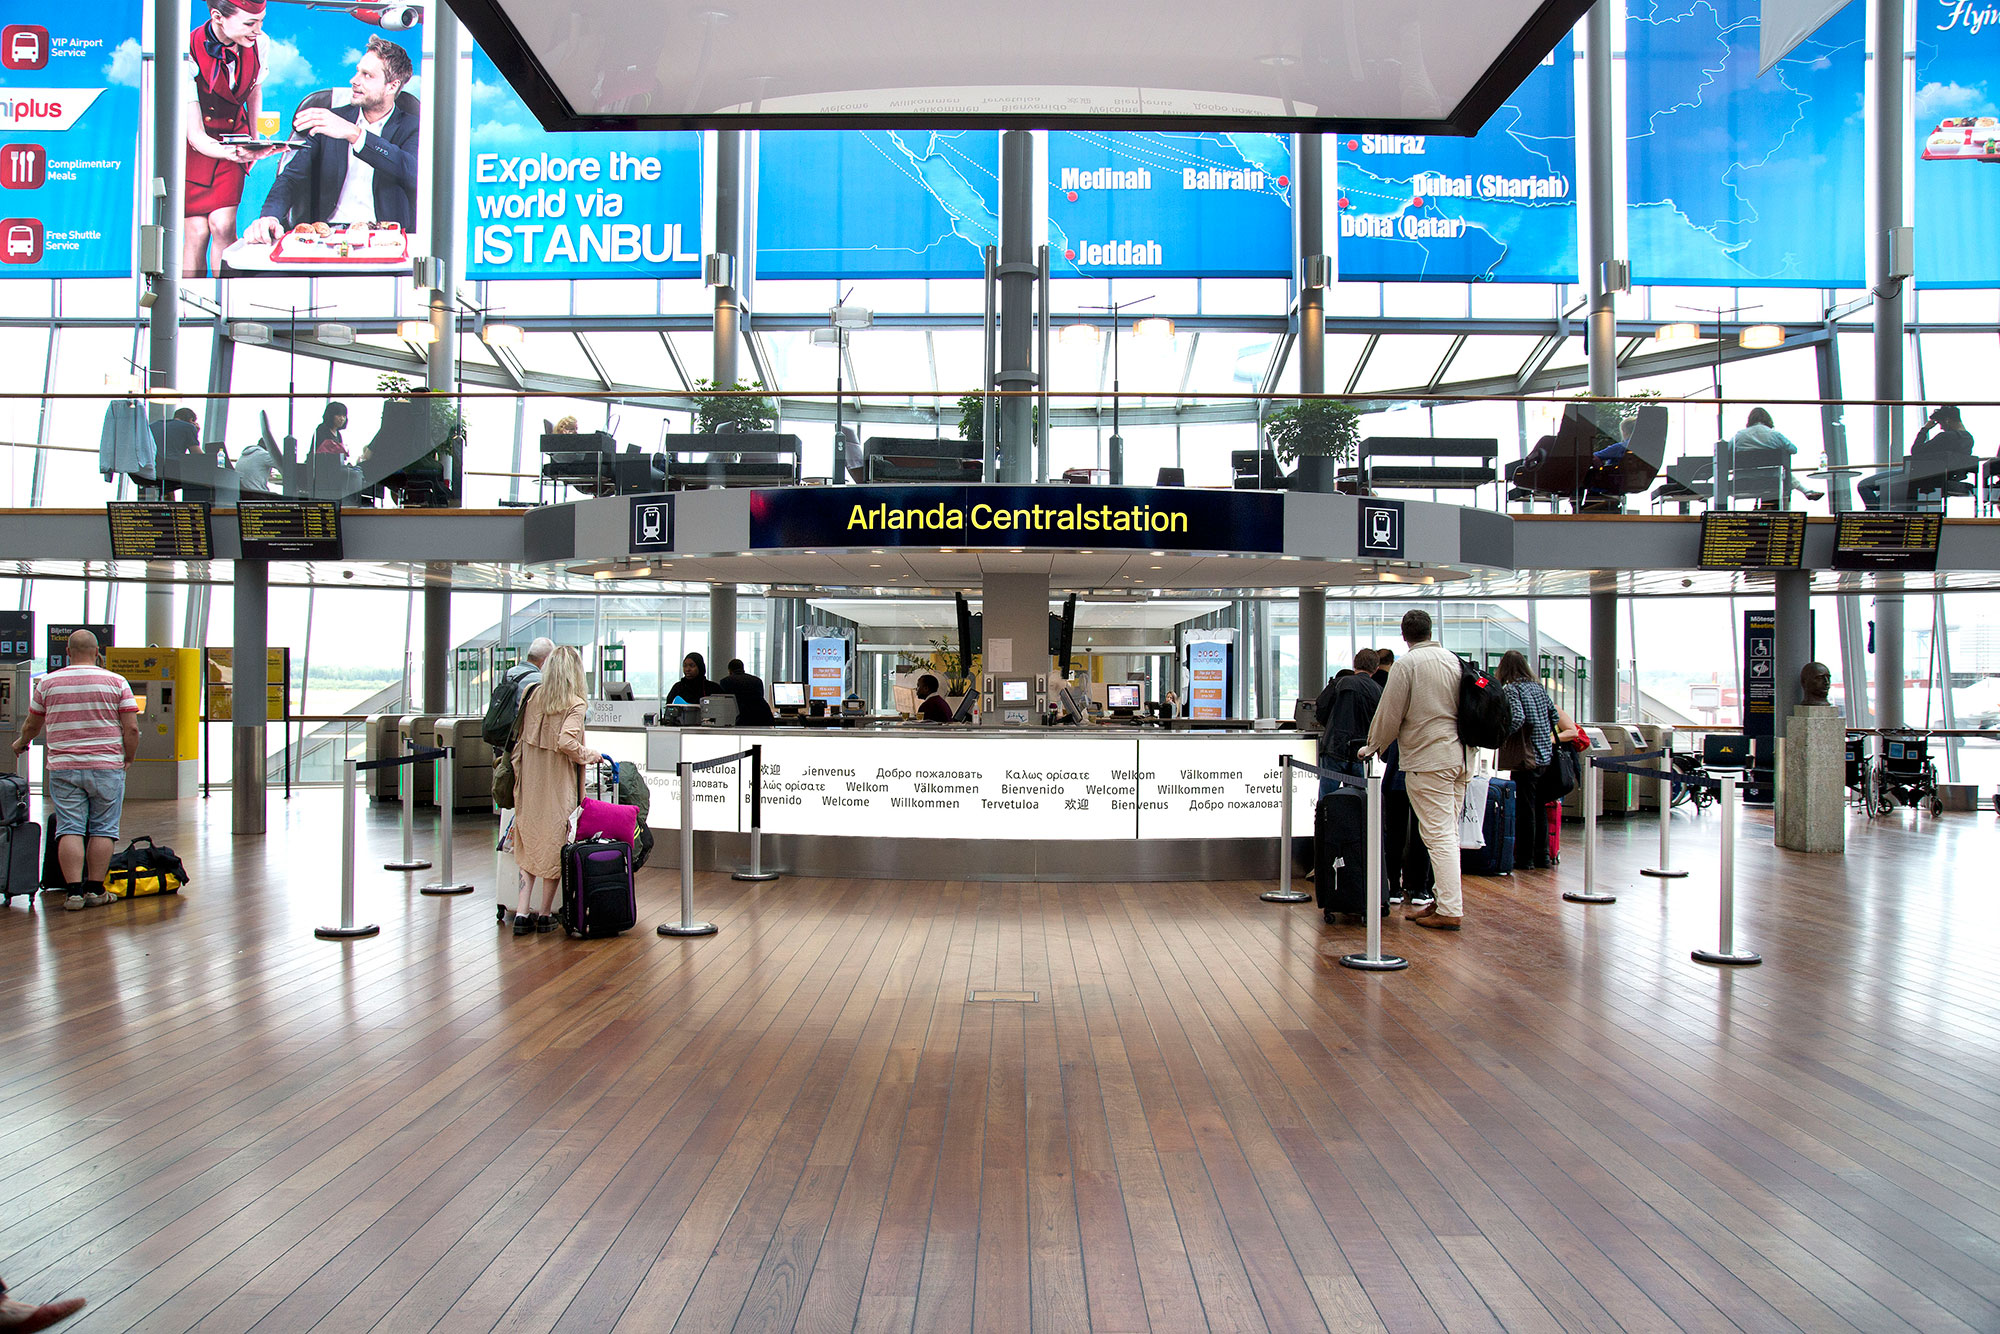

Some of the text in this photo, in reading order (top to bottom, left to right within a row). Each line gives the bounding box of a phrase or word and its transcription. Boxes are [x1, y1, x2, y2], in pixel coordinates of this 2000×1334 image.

[51, 38, 103, 49] VIP Airport
[51, 48, 86, 57] Service
[1362, 134, 1426, 155] Shiraz
[47, 159, 121, 171] Complimentary
[476, 151, 662, 190] Explore the
[47, 171, 77, 181] Meals
[1061, 167, 1152, 190] Medinah
[1183, 167, 1265, 190] Bahrain
[1412, 174, 1570, 199] Dubai (Sharjah)
[476, 187, 623, 219] world via
[46, 230, 102, 240] Free Shuttle
[1340, 214, 1467, 239] Doha (Qatar)
[45, 241, 80, 250] Service
[474, 223, 699, 265] ISTANBUL
[1078, 240, 1162, 265] Jeddah
[847, 503, 1188, 533] Arlanda Centralstation
[802, 766, 856, 778] ienvenus
[876, 767, 912, 780] Добро
[915, 770, 983, 780] пожаловать
[1111, 769, 1156, 781] Welkom
[1180, 769, 1243, 780] Välkommen
[846, 781, 889, 793] Welkom
[914, 782, 979, 794] Välkommen
[1001, 783, 1065, 795] Bienvenido
[1086, 784, 1136, 796] Welcome
[1157, 784, 1225, 795] Willkommen
[1245, 784, 1298, 794] Tervetua
[744, 793, 802, 806] Bnvenido
[822, 795, 870, 807] Welcome
[891, 797, 960, 809] Willkommen
[981, 798, 1039, 810] Tervetuloa
[1065, 798, 1089, 811] 欢迎
[1111, 799, 1169, 810] Bienvenus
[1189, 799, 1224, 812] Добро
[1227, 800, 1283, 810] пожалова
